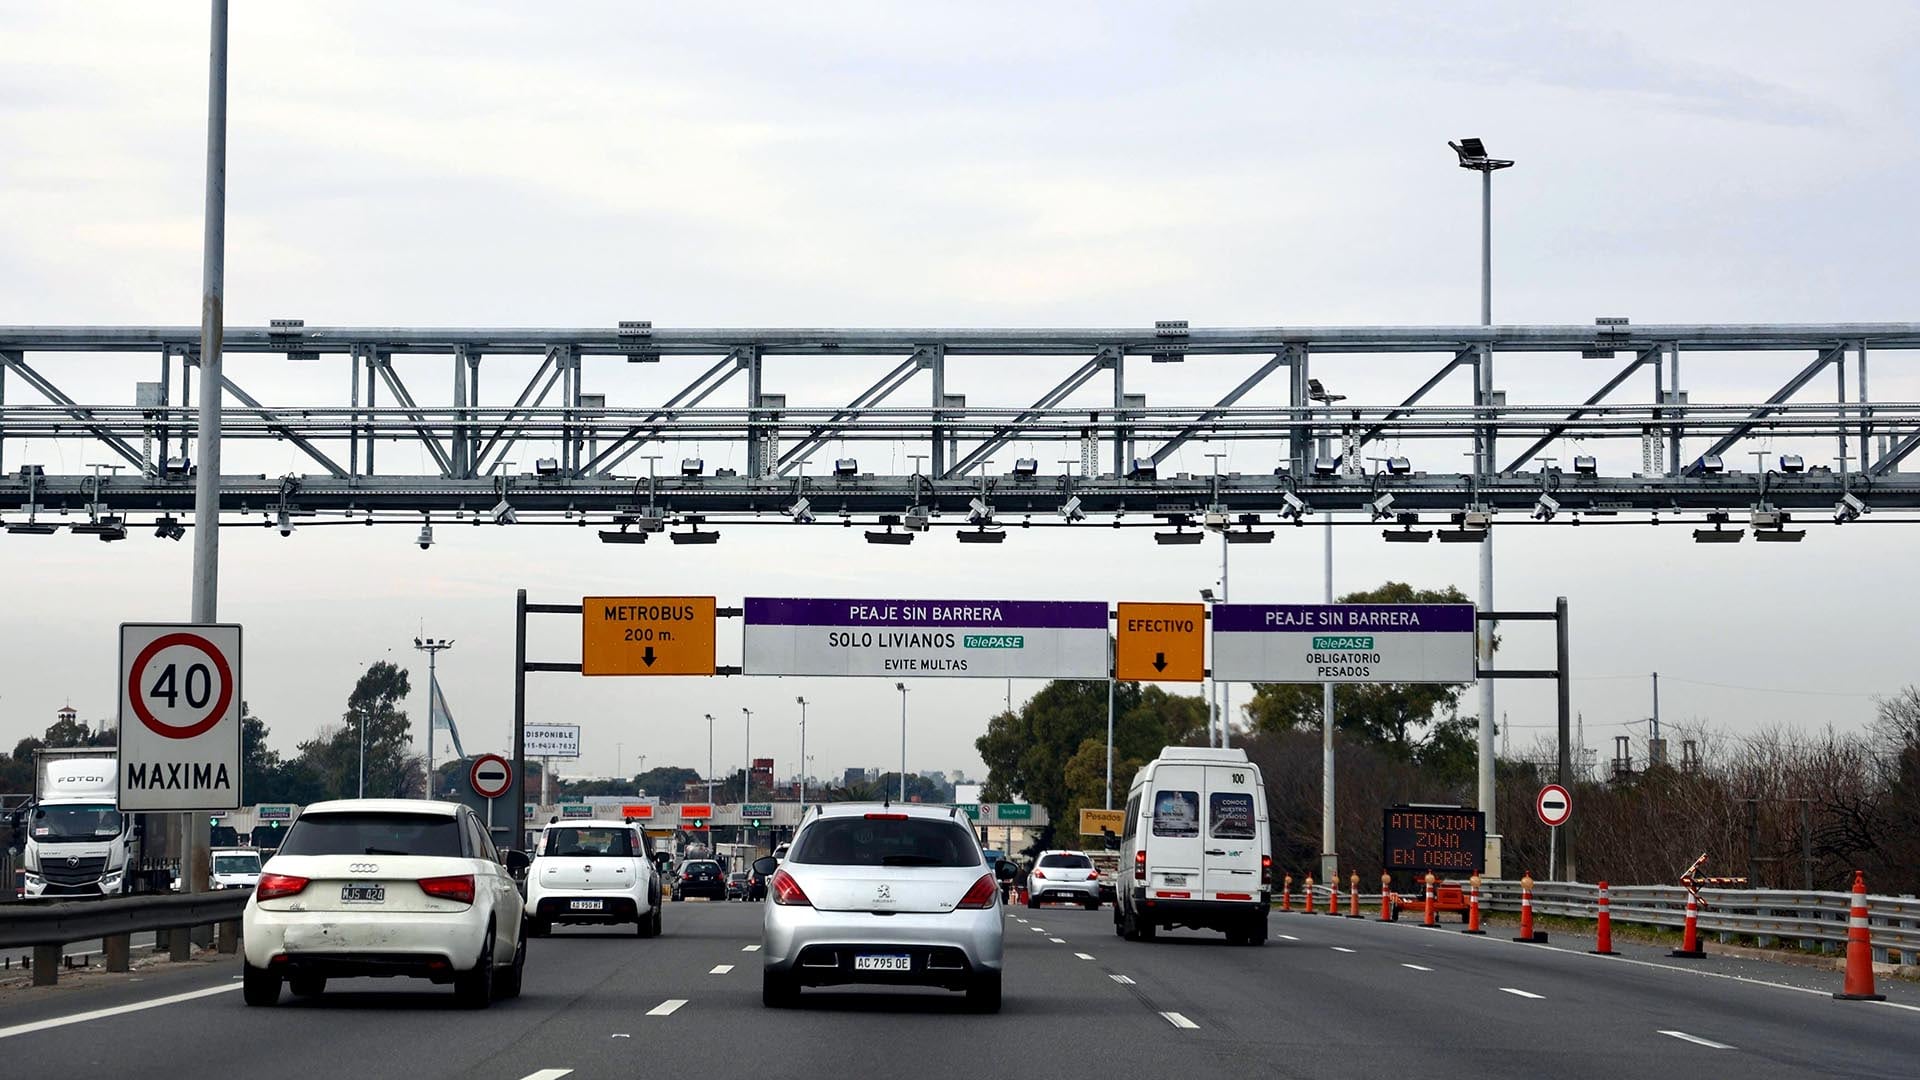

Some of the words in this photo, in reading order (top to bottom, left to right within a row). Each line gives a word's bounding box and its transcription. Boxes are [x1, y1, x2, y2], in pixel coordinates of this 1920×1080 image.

[604, 606, 694, 620] METROBUS
[850, 606, 898, 620] PEAJE
[903, 607, 927, 620] SIN
[932, 607, 1002, 621] BARRERA
[1265, 612, 1314, 625] PEAJE
[1319, 612, 1343, 625] SIN
[1349, 612, 1420, 625] BARRERA
[1128, 619, 1194, 632] EFECTIVO
[624, 628, 654, 641] 200
[659, 631, 675, 641] m.
[829, 633, 872, 647] SOLO
[878, 633, 955, 648] LIVIANOS
[965, 636, 1022, 648] TelePASE
[1315, 638, 1372, 649] TelePASE
[884, 659, 917, 670] EVITE
[920, 659, 968, 670] MULTAS
[1306, 653, 1380, 664] OBLIGATORIO
[1318, 666, 1370, 677] PESADOS
[150, 663, 211, 709] 40
[526, 731, 573, 739] DISPONIBLE
[128, 763, 230, 789] MAXIMA
[1232, 773, 1245, 784] 100
[1086, 811, 1120, 821] Pesados
[1392, 813, 1476, 831] ATENCION
[1416, 832, 1459, 848] ZONA
[1393, 849, 1416, 865] EN
[1423, 850, 1473, 867] OBRAS
[342, 888, 361, 899] MJS
[365, 888, 383, 900] 424
[858, 958, 870, 968] AC
[873, 958, 892, 968] 795
